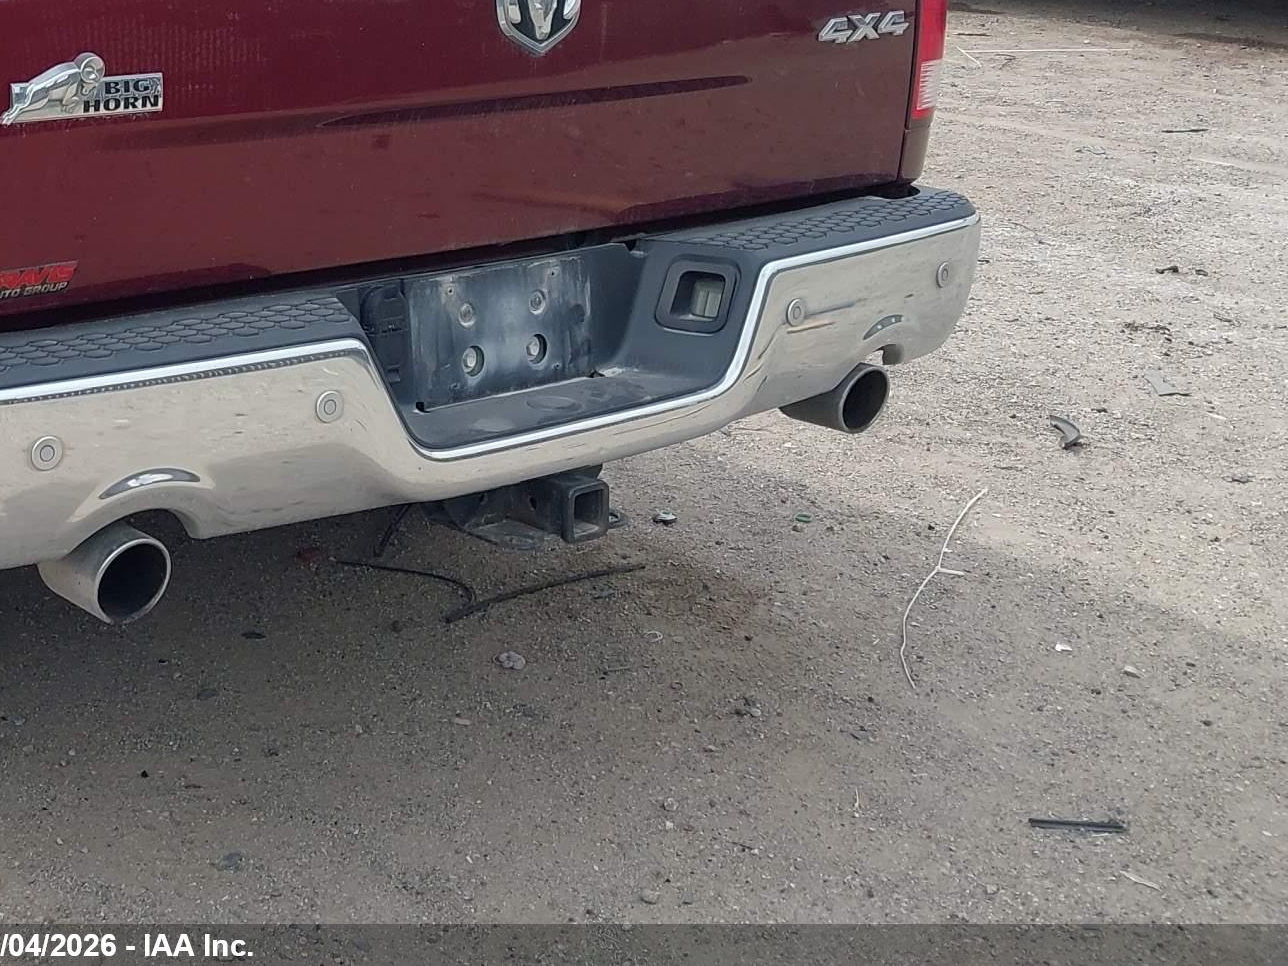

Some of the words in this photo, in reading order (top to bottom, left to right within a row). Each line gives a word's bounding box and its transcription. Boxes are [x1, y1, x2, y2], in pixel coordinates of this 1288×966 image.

[105, 79, 150, 95] BIG
[83, 95, 159, 113] HORN
[23, 281, 68, 296] GROUP
